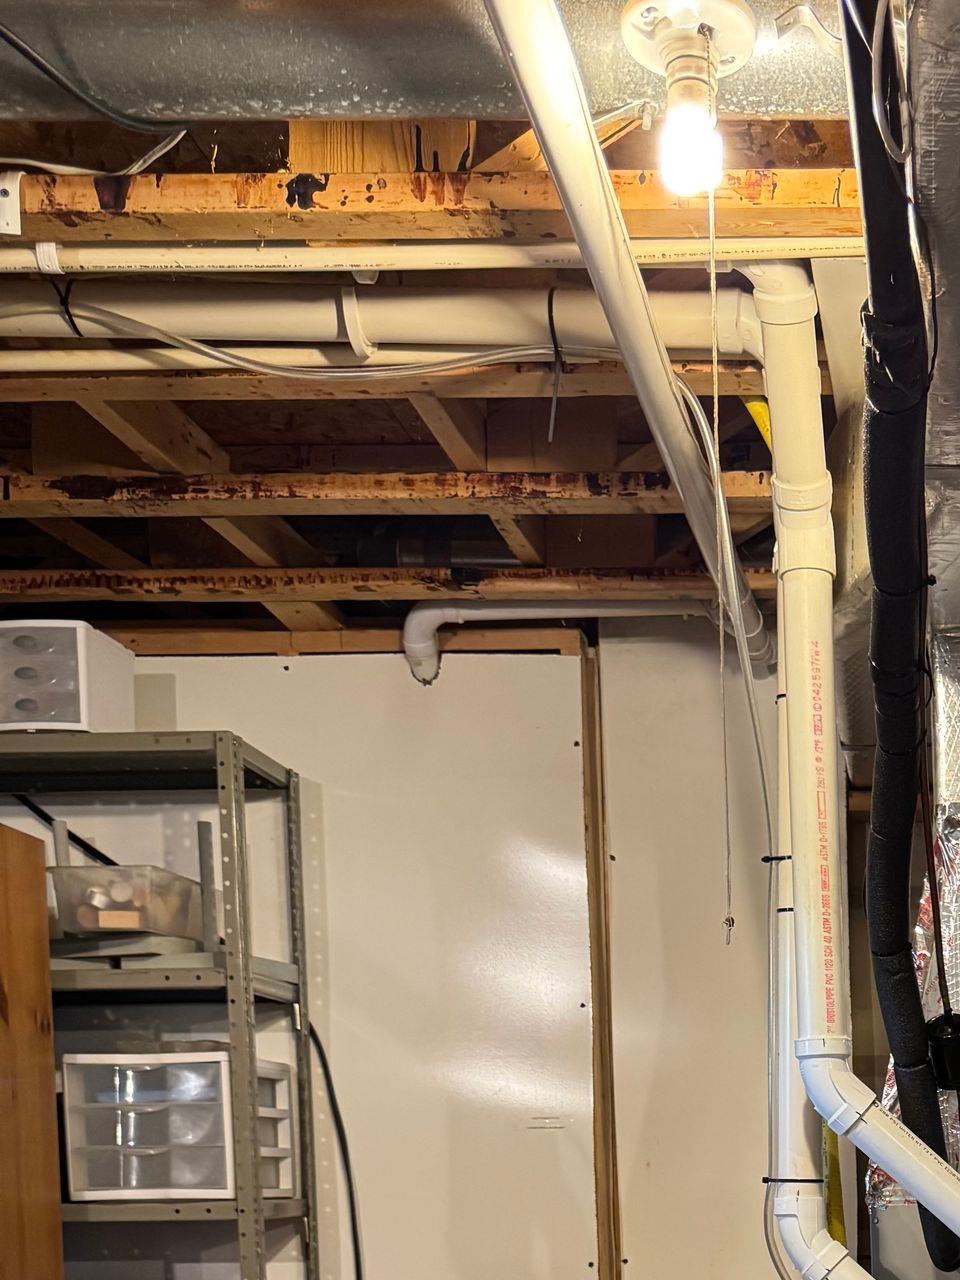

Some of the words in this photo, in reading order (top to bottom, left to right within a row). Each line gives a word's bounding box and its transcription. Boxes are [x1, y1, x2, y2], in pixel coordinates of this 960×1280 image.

[819, 844, 828, 861] ASTM
[822, 916, 831, 934] ASTM
[823, 935, 832, 943] 40
[823, 945, 832, 957] SCH
[824, 958, 833, 970] 1120
[825, 973, 833, 984] PVC
